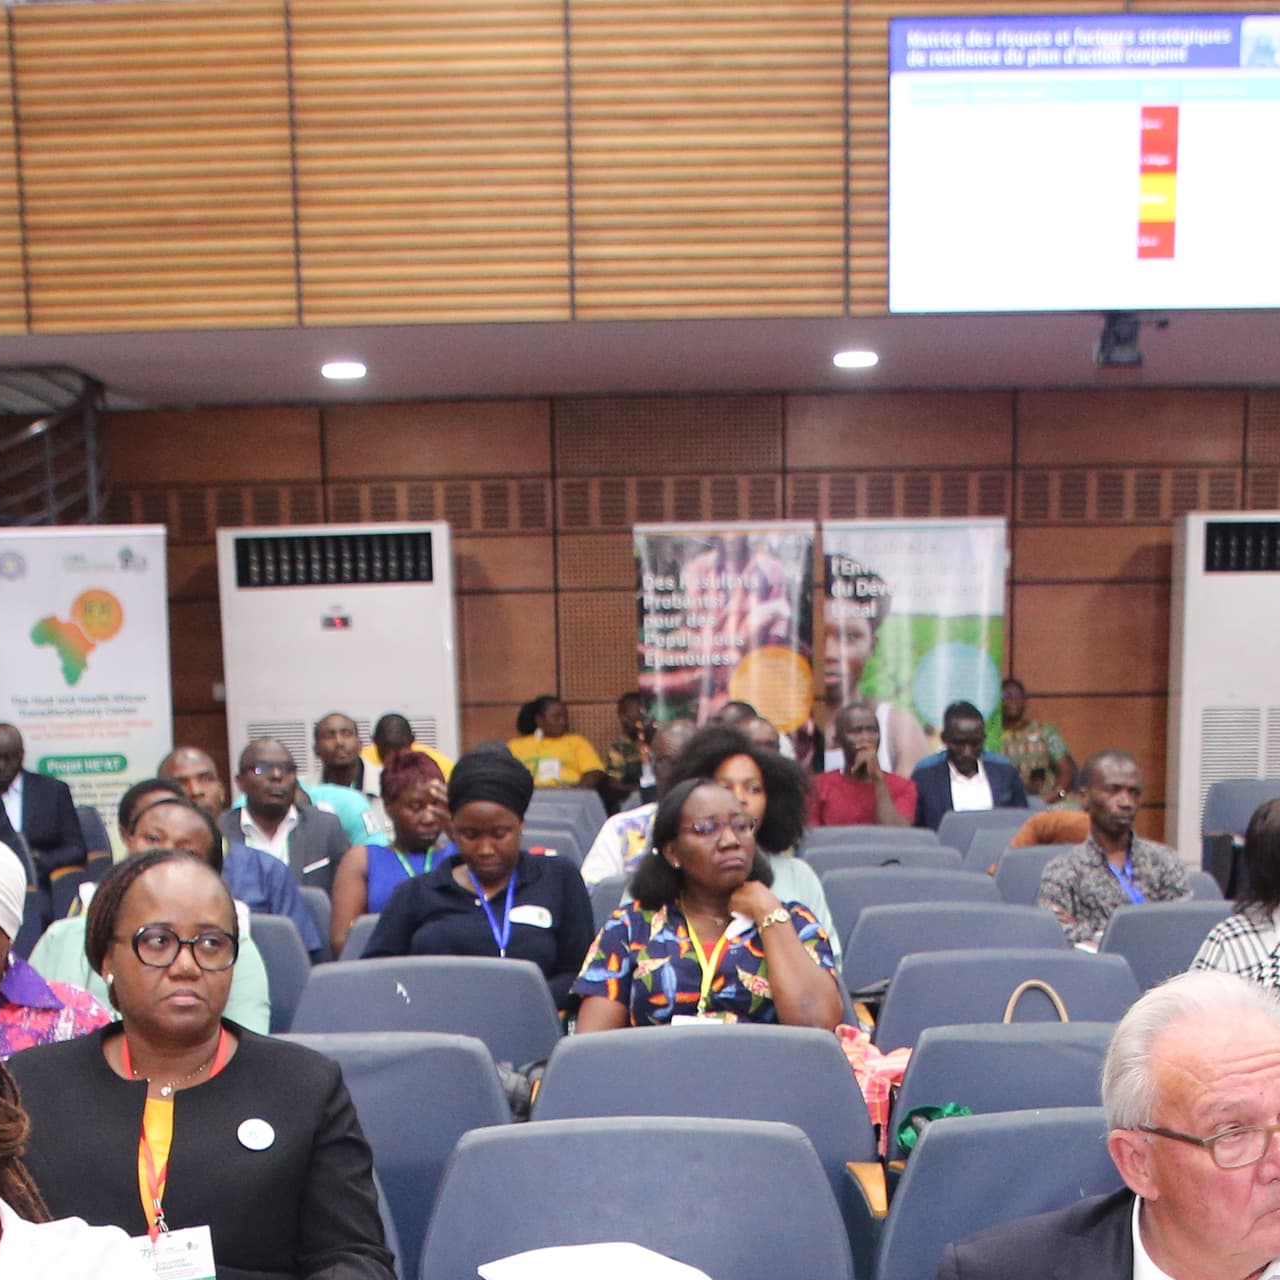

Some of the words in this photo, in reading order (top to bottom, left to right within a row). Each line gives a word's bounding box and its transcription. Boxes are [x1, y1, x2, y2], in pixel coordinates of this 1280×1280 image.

[907, 29, 963, 49] Matrice
[965, 28, 993, 48] des
[996, 27, 1052, 51] risques
[1054, 28, 1071, 47] et
[1073, 26, 1136, 47] facteurs
[906, 49, 926, 68] de
[1003, 47, 1022, 66] du
[1026, 46, 1060, 69] plan
[643, 574, 674, 591] Des
[831, 577, 853, 597] du
[686, 612, 718, 629] des
